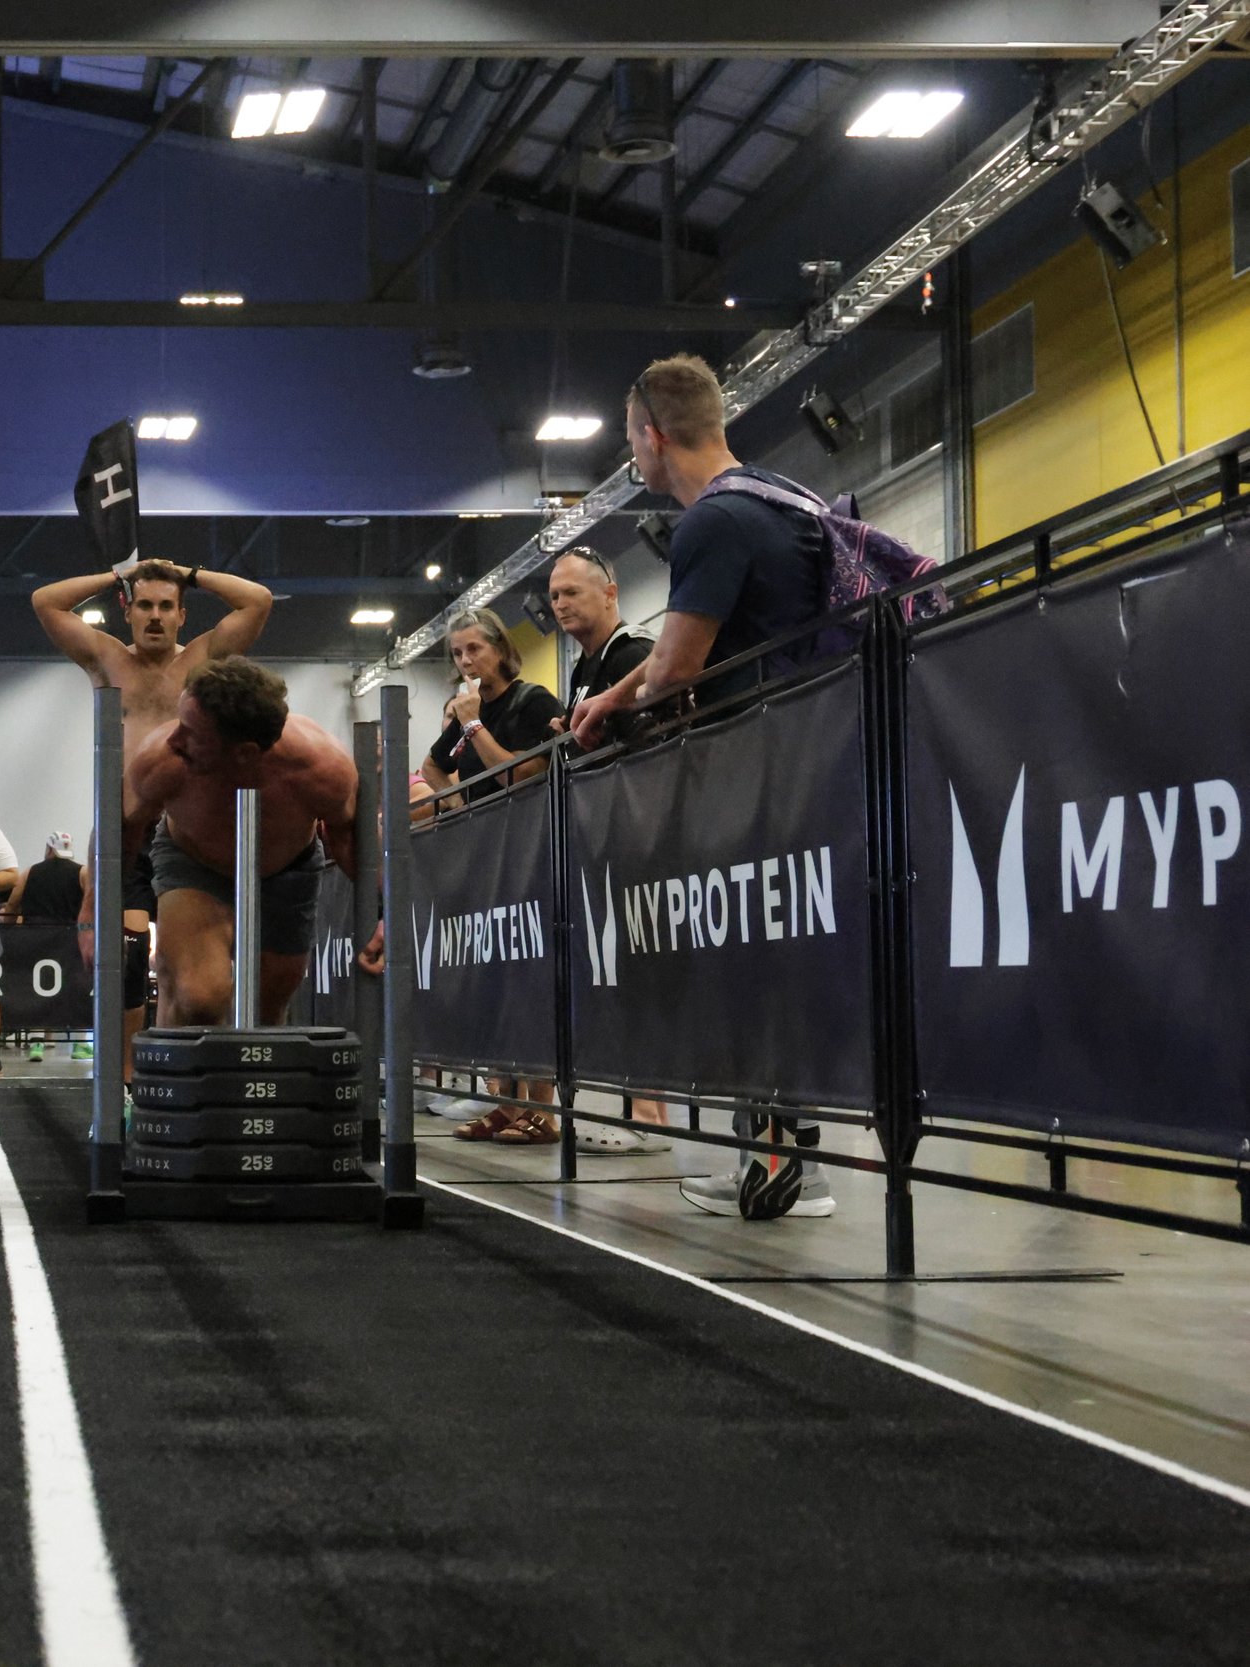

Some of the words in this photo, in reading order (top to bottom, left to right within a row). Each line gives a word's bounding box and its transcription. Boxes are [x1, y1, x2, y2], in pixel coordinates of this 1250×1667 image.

[439, 899, 544, 968] MYPROTEIN
[624, 845, 837, 955] MYPROTEIN
[137, 1086, 173, 1097] HYROX
